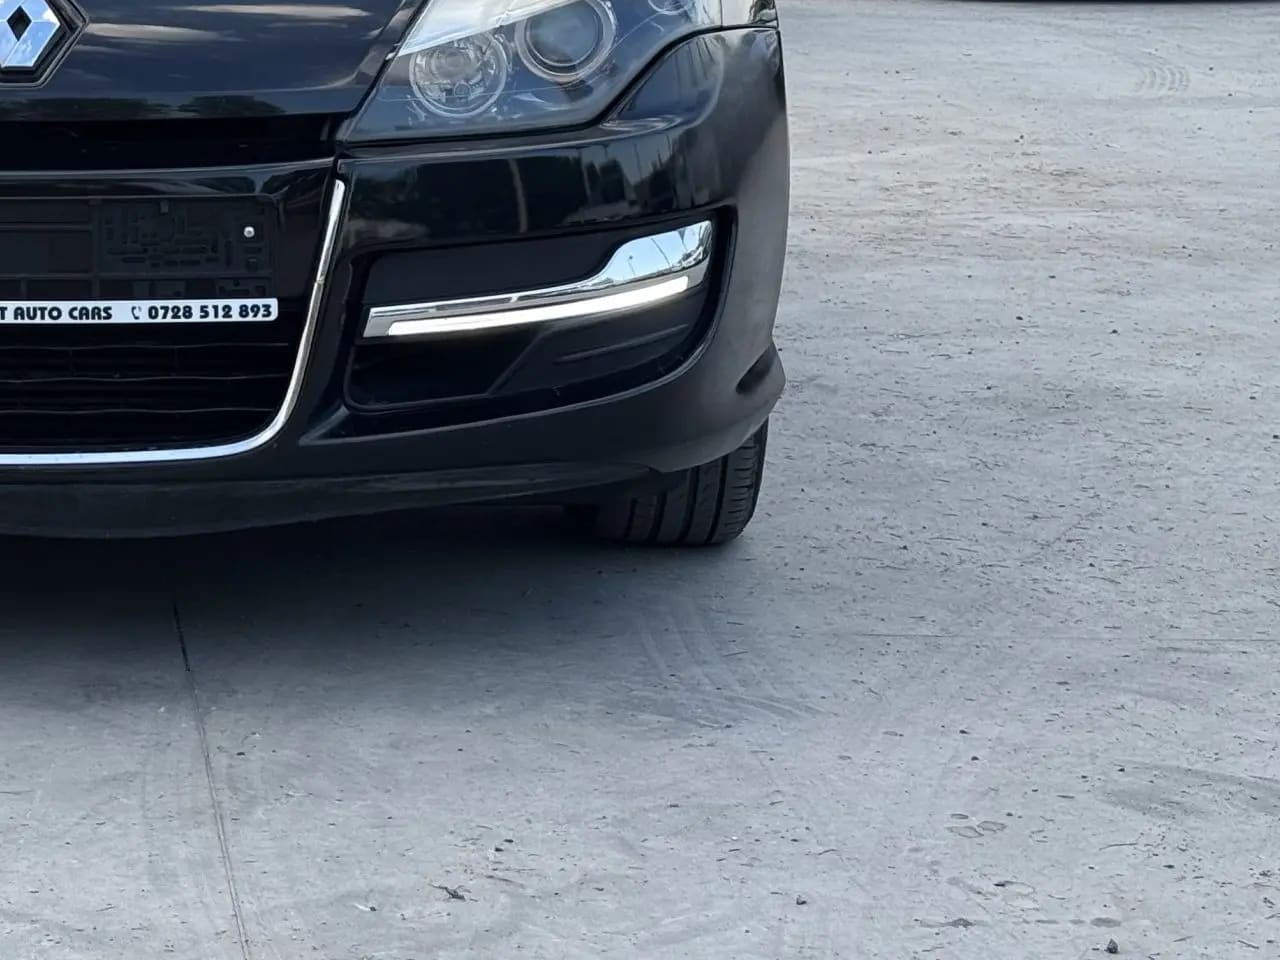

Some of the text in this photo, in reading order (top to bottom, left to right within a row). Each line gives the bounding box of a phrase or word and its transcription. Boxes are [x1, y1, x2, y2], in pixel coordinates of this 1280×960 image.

[13, 306, 63, 320] AUTO
[68, 306, 113, 320] CARS
[147, 304, 193, 319] 0728
[199, 304, 233, 319] 512
[238, 303, 273, 318] 893
